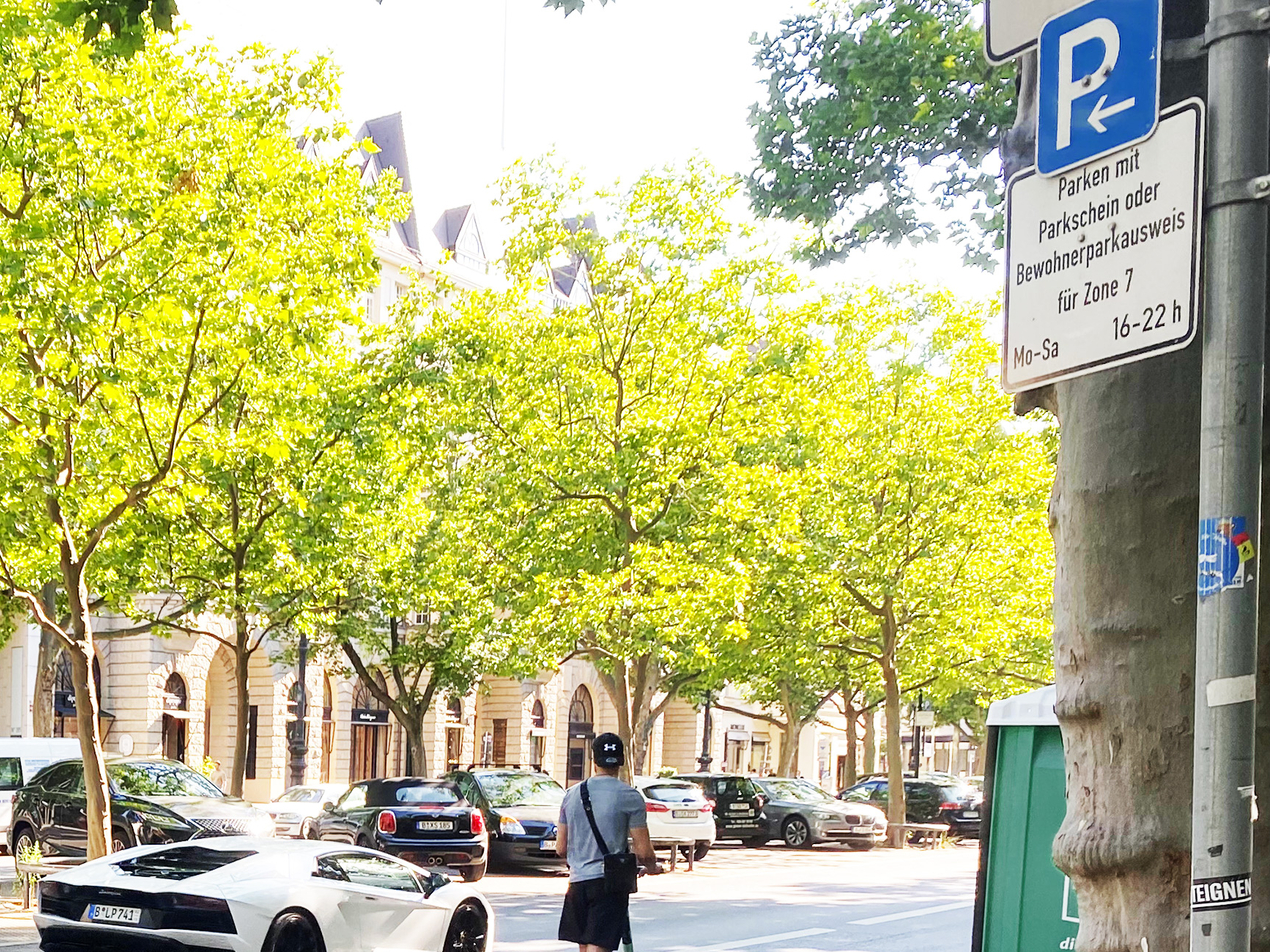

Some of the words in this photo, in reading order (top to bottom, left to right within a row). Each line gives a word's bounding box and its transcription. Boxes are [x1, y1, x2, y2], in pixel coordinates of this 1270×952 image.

[1055, 17, 1120, 151] P
[1058, 165, 1110, 201] Parken
[1115, 148, 1140, 178] mit
[1038, 194, 1119, 244] Parkschein
[1125, 181, 1160, 210] oder
[1016, 207, 1186, 286] Bewohnerparkausweis
[1058, 288, 1078, 314] für
[1084, 279, 1118, 306] Zone
[1125, 267, 1134, 293] 7
[1113, 303, 1166, 341] 16-22
[1172, 299, 1182, 324] h
[1013, 338, 1059, 369] Mo-Sa
[95, 906, 101, 917] B
